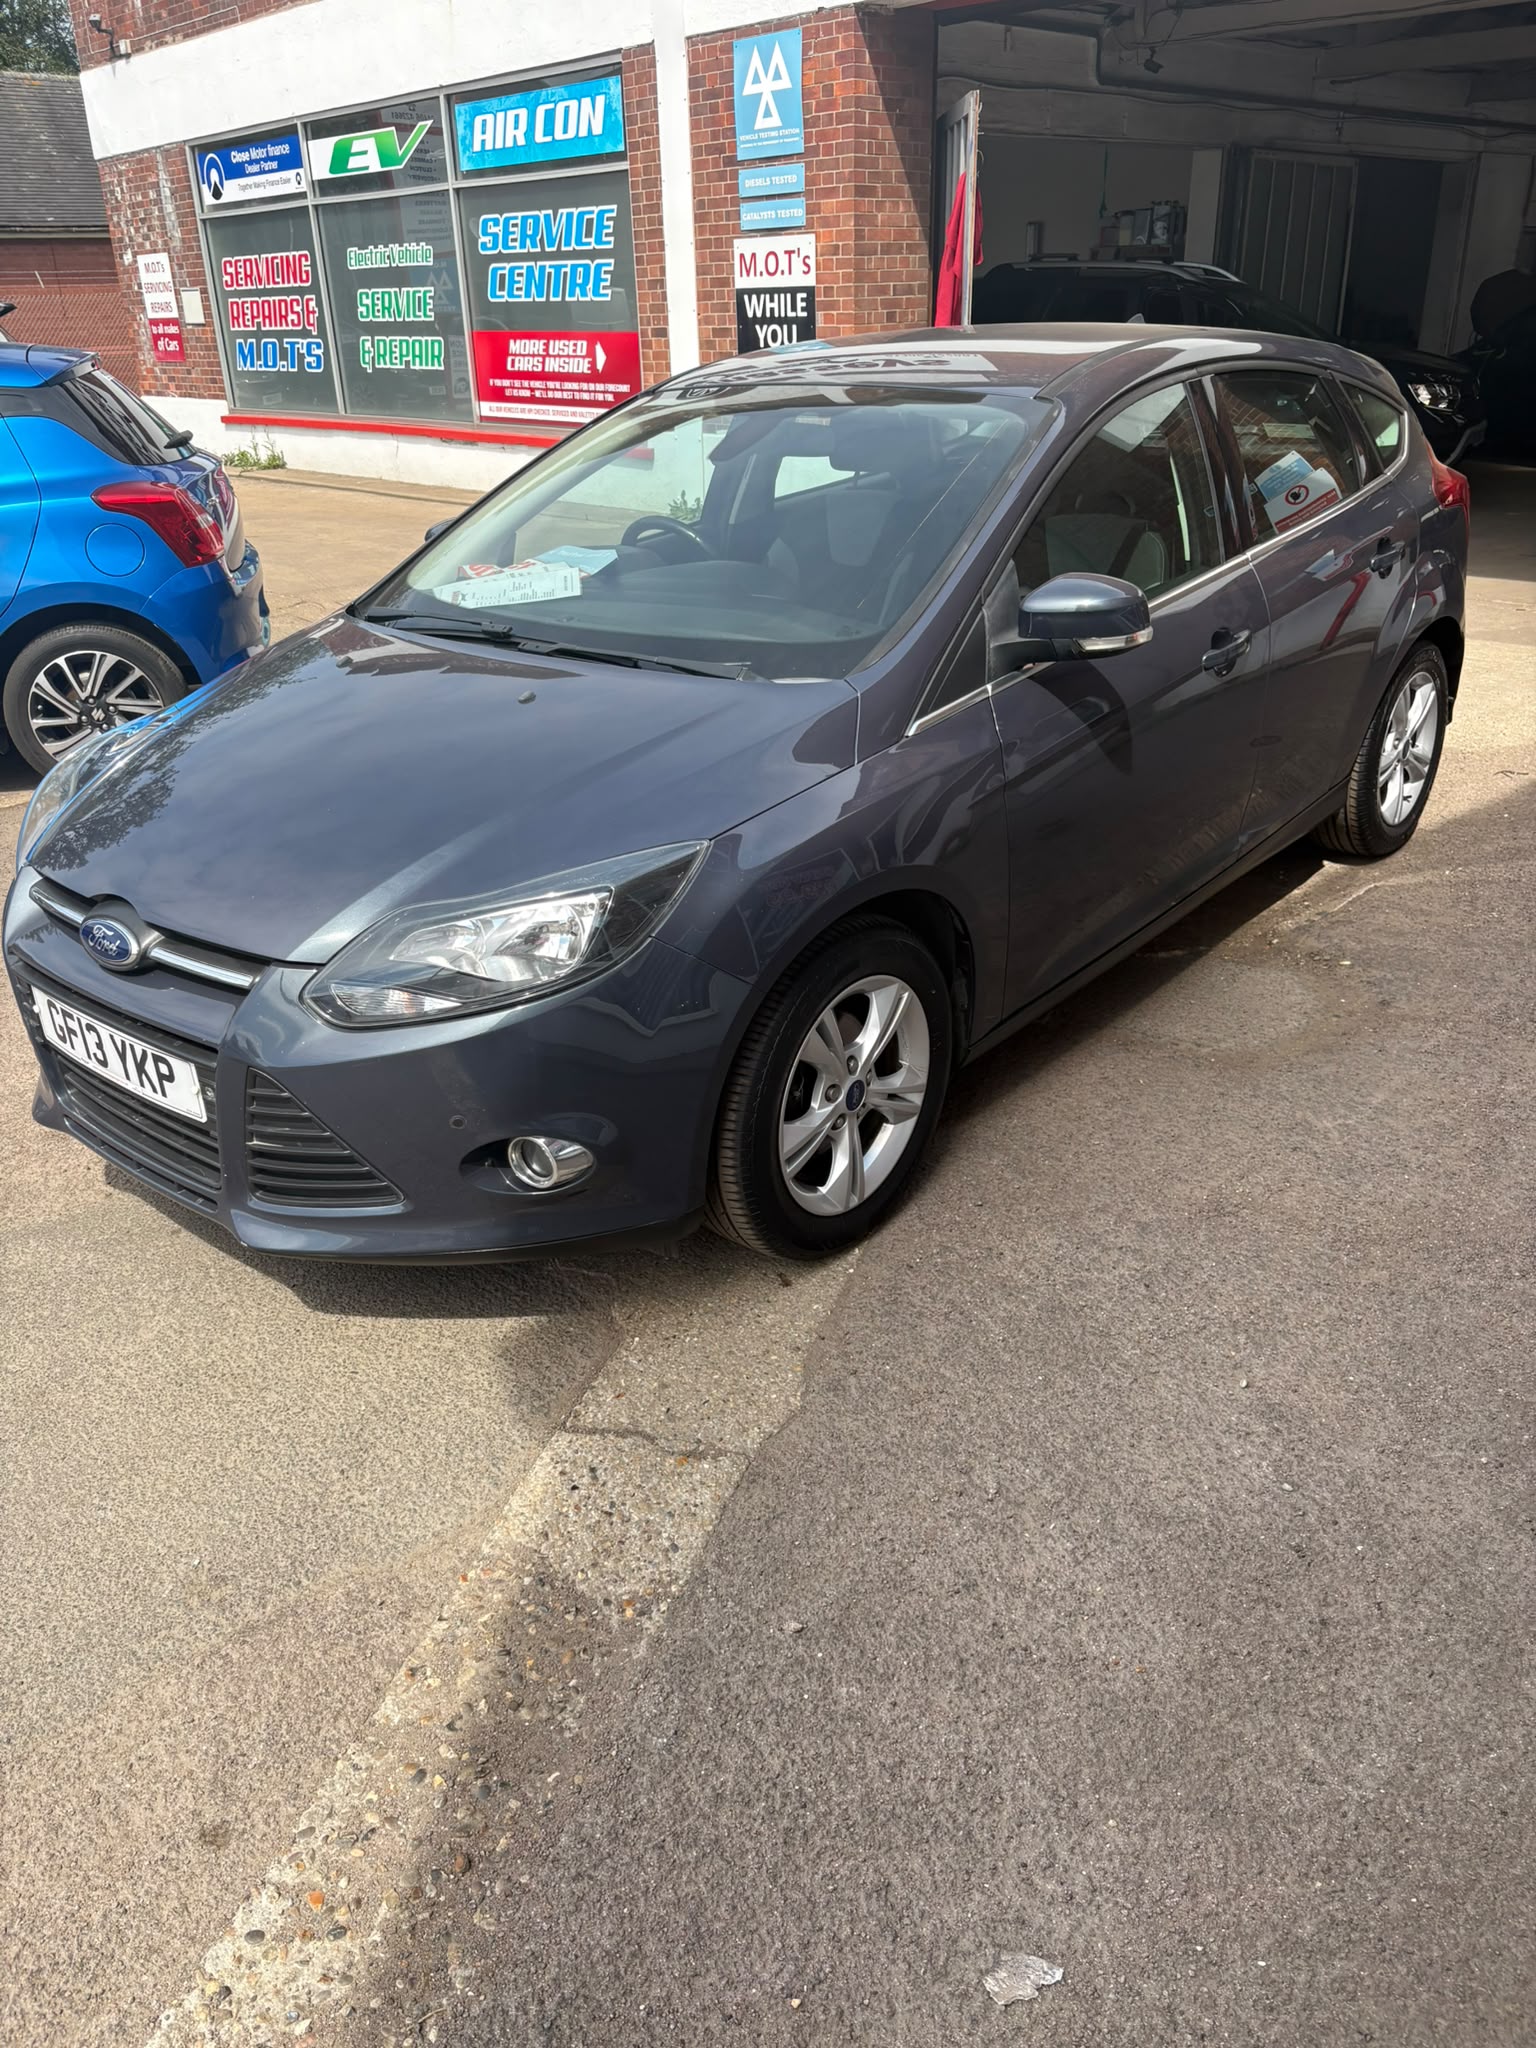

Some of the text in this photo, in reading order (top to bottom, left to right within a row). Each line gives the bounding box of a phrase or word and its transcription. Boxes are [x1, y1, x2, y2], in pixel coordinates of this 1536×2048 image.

[472, 107, 529, 153] AIR
[534, 94, 606, 144] CON
[740, 128, 800, 142] VEHICLE TESTING STATION
[230, 143, 290, 163] Close Motor finance
[328, 122, 431, 175] EV
[244, 160, 278, 174] Dealer Partner
[745, 174, 797, 188] DIESELS TESTED
[742, 208, 803, 221] CATALYSTS TESTED
[478, 204, 618, 255] SERVICE
[347, 242, 434, 270] Electric Vehicle
[739, 247, 812, 278] M.O.T's
[221, 250, 312, 291] SERVICING
[487, 258, 615, 303] CENTRE
[144, 281, 173, 294] SERVICING
[150, 301, 173, 313] REPAIRS
[228, 294, 319, 335] REPAIRS &
[357, 287, 435, 322] SERVICE
[743, 292, 808, 318] WHILE
[151, 325, 158, 334] to
[164, 324, 180, 334] makes
[755, 323, 798, 349] YOU
[157, 337, 180, 351] of Cars
[236, 338, 324, 373] M.O.T'S
[360, 336, 373, 373] &
[375, 336, 445, 370] REPAIR
[509, 338, 588, 357] MORE USED
[506, 355, 592, 374] CARS INSIDE
[87, 923, 122, 957] Ford
[46, 998, 176, 1099] GF13 YKP
